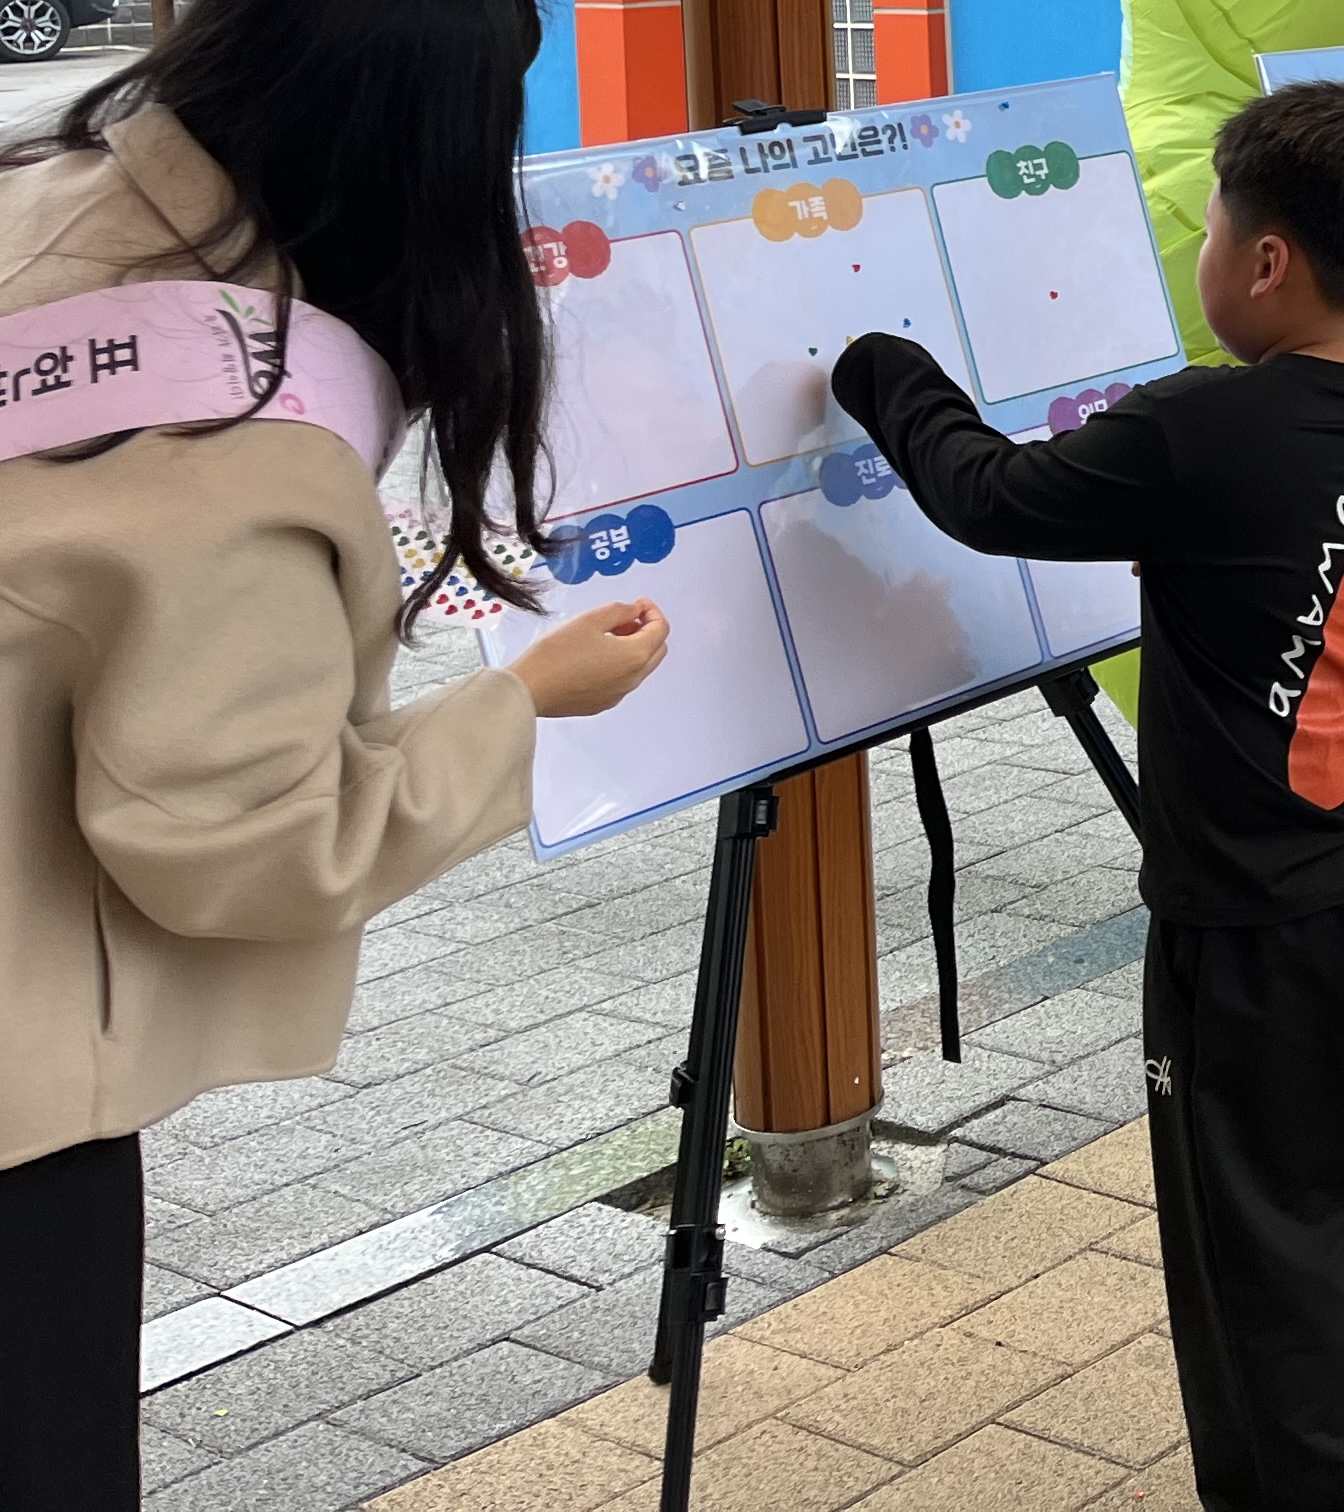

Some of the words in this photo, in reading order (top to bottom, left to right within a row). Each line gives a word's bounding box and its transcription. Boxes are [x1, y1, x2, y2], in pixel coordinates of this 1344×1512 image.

[674, 148, 735, 187] 요즘
[740, 138, 799, 175] 나의
[802, 123, 909, 167] 고민은?!
[1016, 156, 1051, 182] 친구
[788, 196, 829, 222] 가족
[854, 455, 893, 485] 진로
[588, 524, 632, 561] 공부
